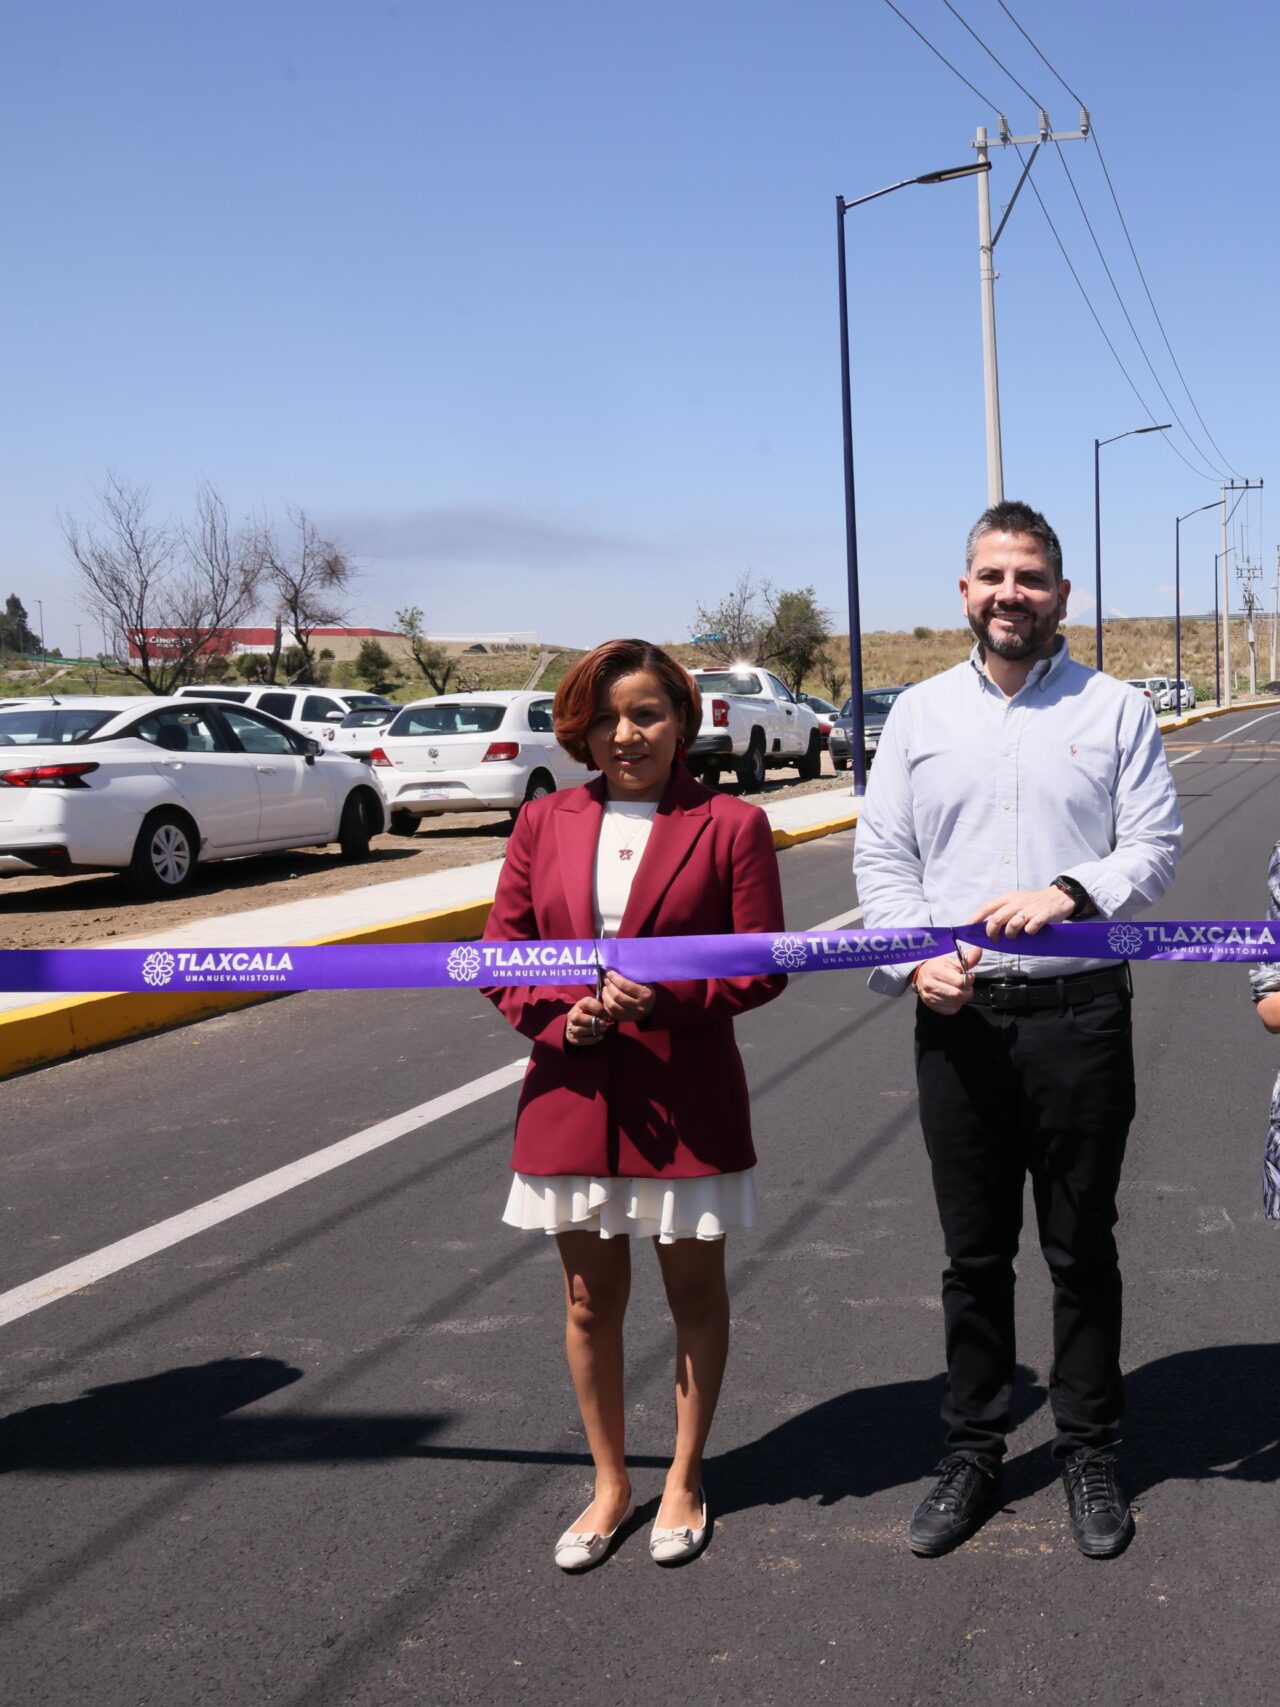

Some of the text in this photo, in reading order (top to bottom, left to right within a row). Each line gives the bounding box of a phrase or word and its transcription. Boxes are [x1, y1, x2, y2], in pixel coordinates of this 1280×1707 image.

[806, 933, 938, 955] TLAXCALA
[1144, 926, 1276, 945] TLAXCALA
[482, 946, 605, 967] TLAXCALA
[822, 949, 933, 964] UNA NUEVA HISTORIA
[1157, 945, 1269, 955] UNA NUEVA HISTORIA
[177, 952, 293, 971] TLAXCALA
[185, 974, 286, 982] UNA NUEVA HISTORIA
[492, 968, 598, 977] UNA NUEVA HISTORIA
